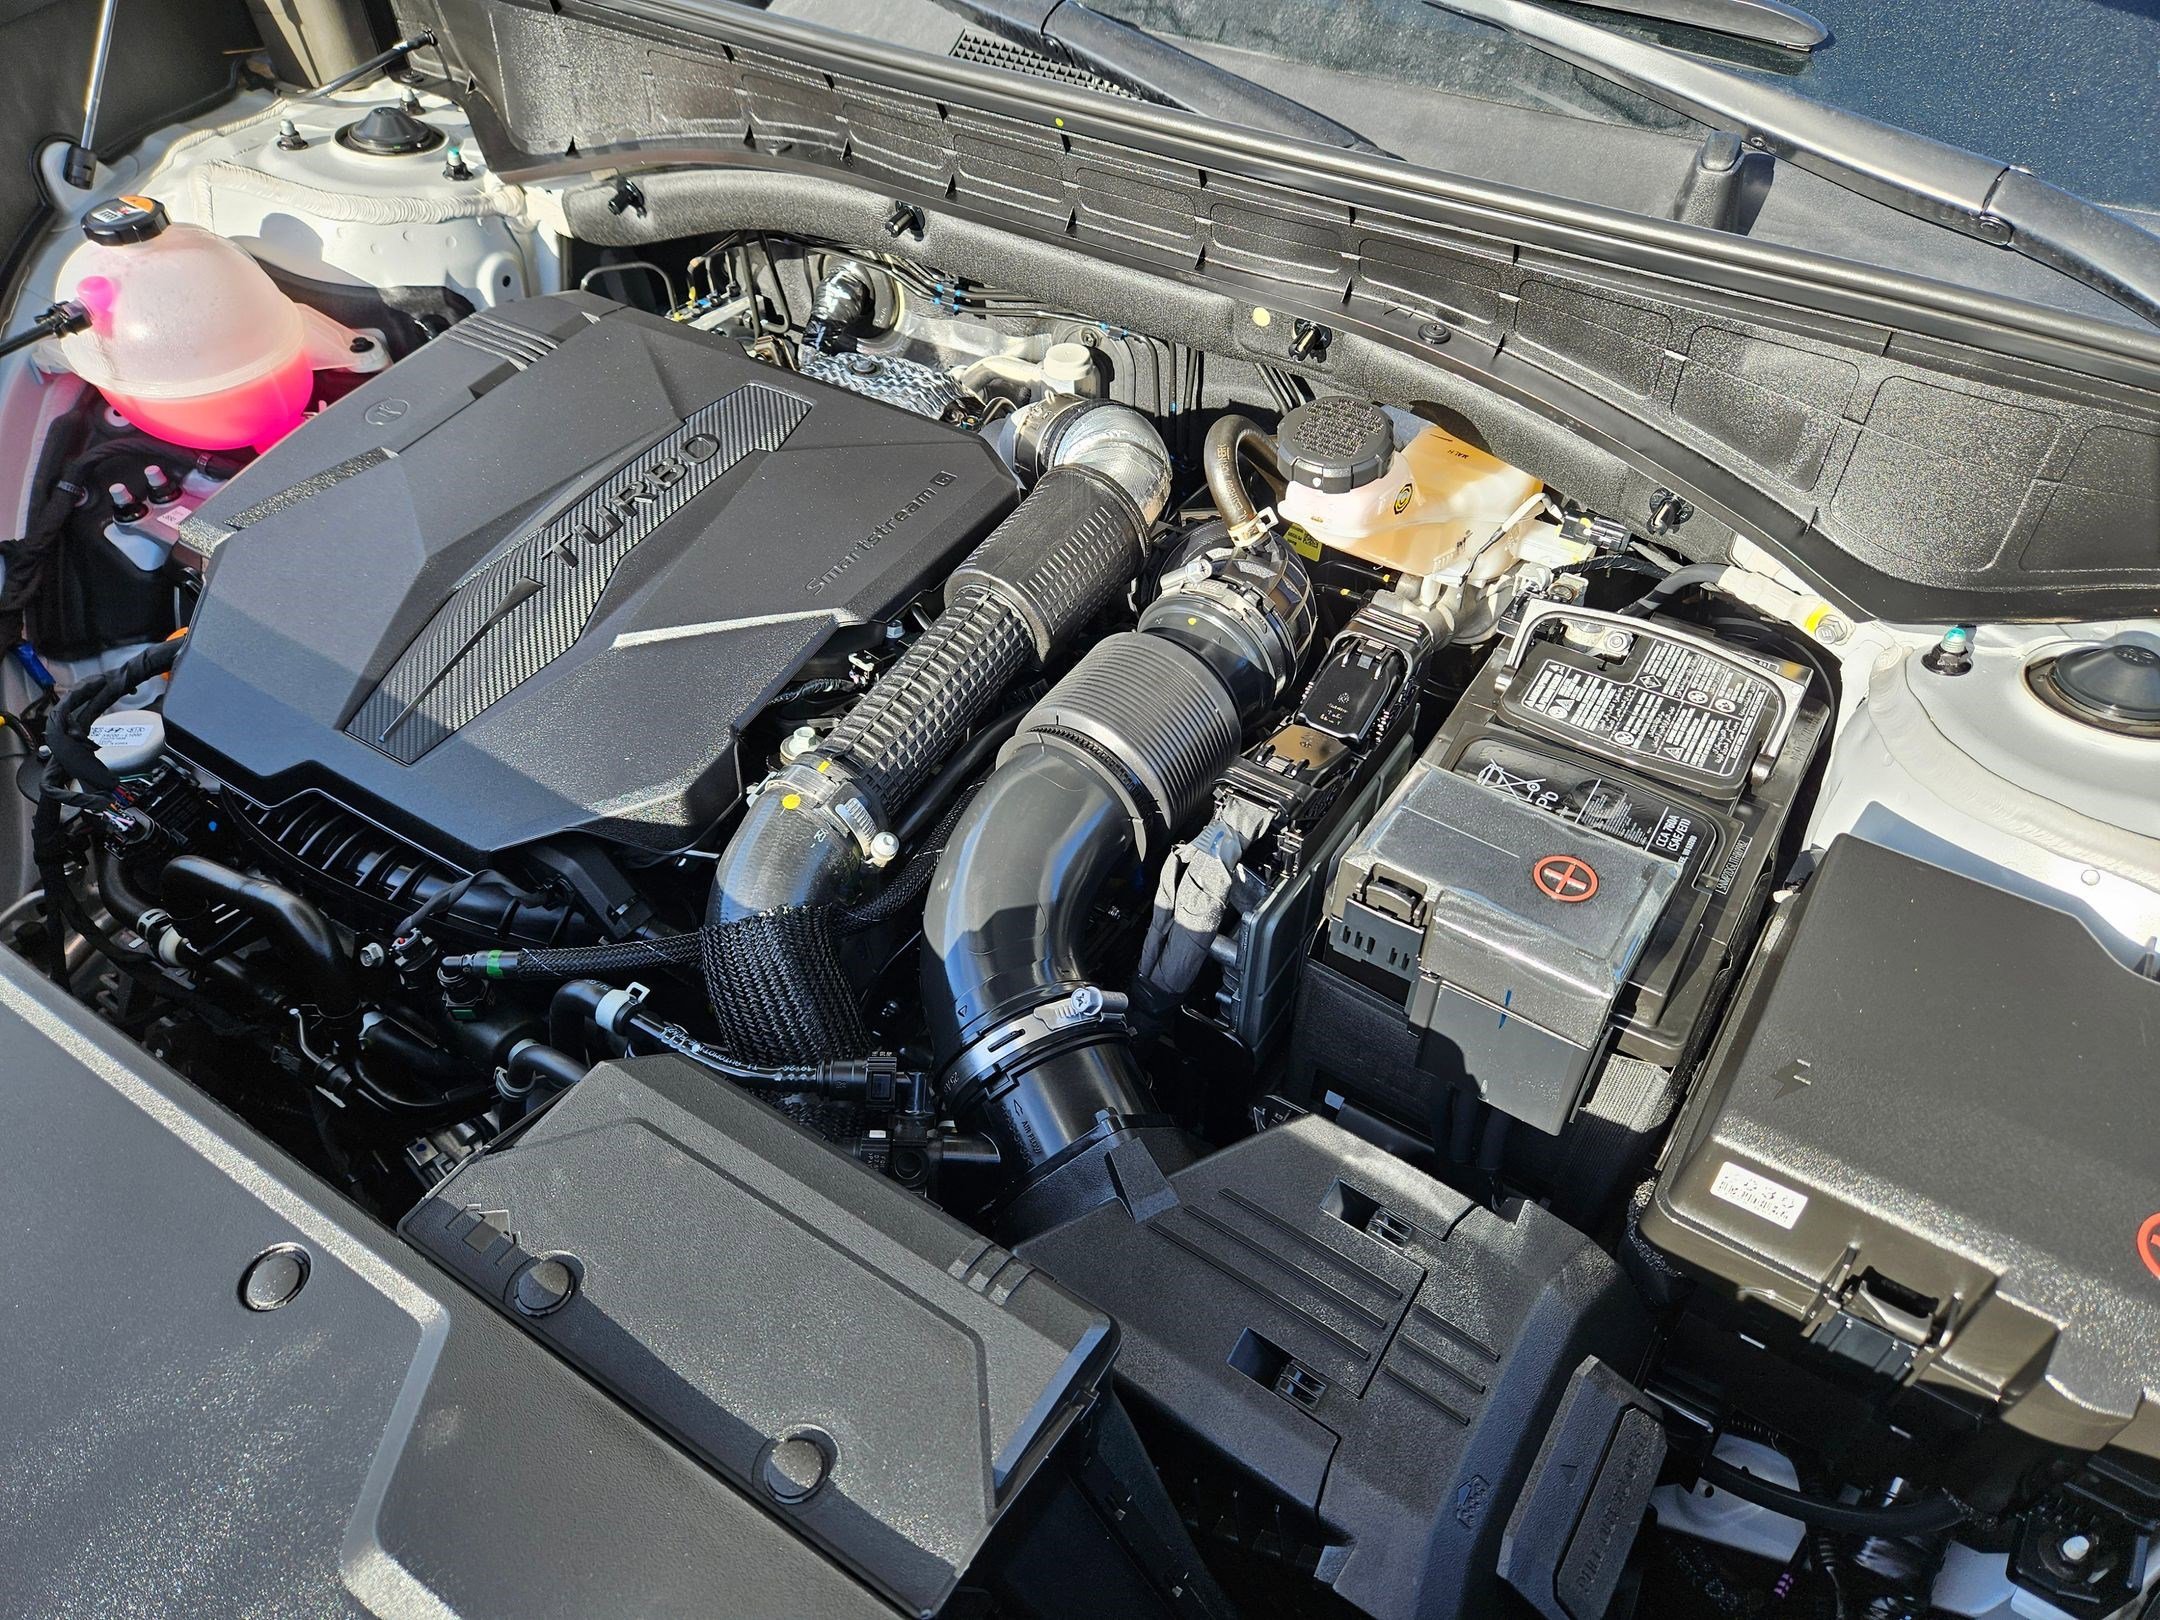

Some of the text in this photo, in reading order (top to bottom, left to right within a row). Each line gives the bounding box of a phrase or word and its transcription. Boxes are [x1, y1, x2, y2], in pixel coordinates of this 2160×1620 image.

[540, 433, 720, 569] TURBO
[804, 487, 937, 596] Smartstream
[1535, 791, 1559, 810] Pb
[1655, 814, 1680, 848] CCA 760A
[1021, 1119, 1042, 1154] AIR FLOW
